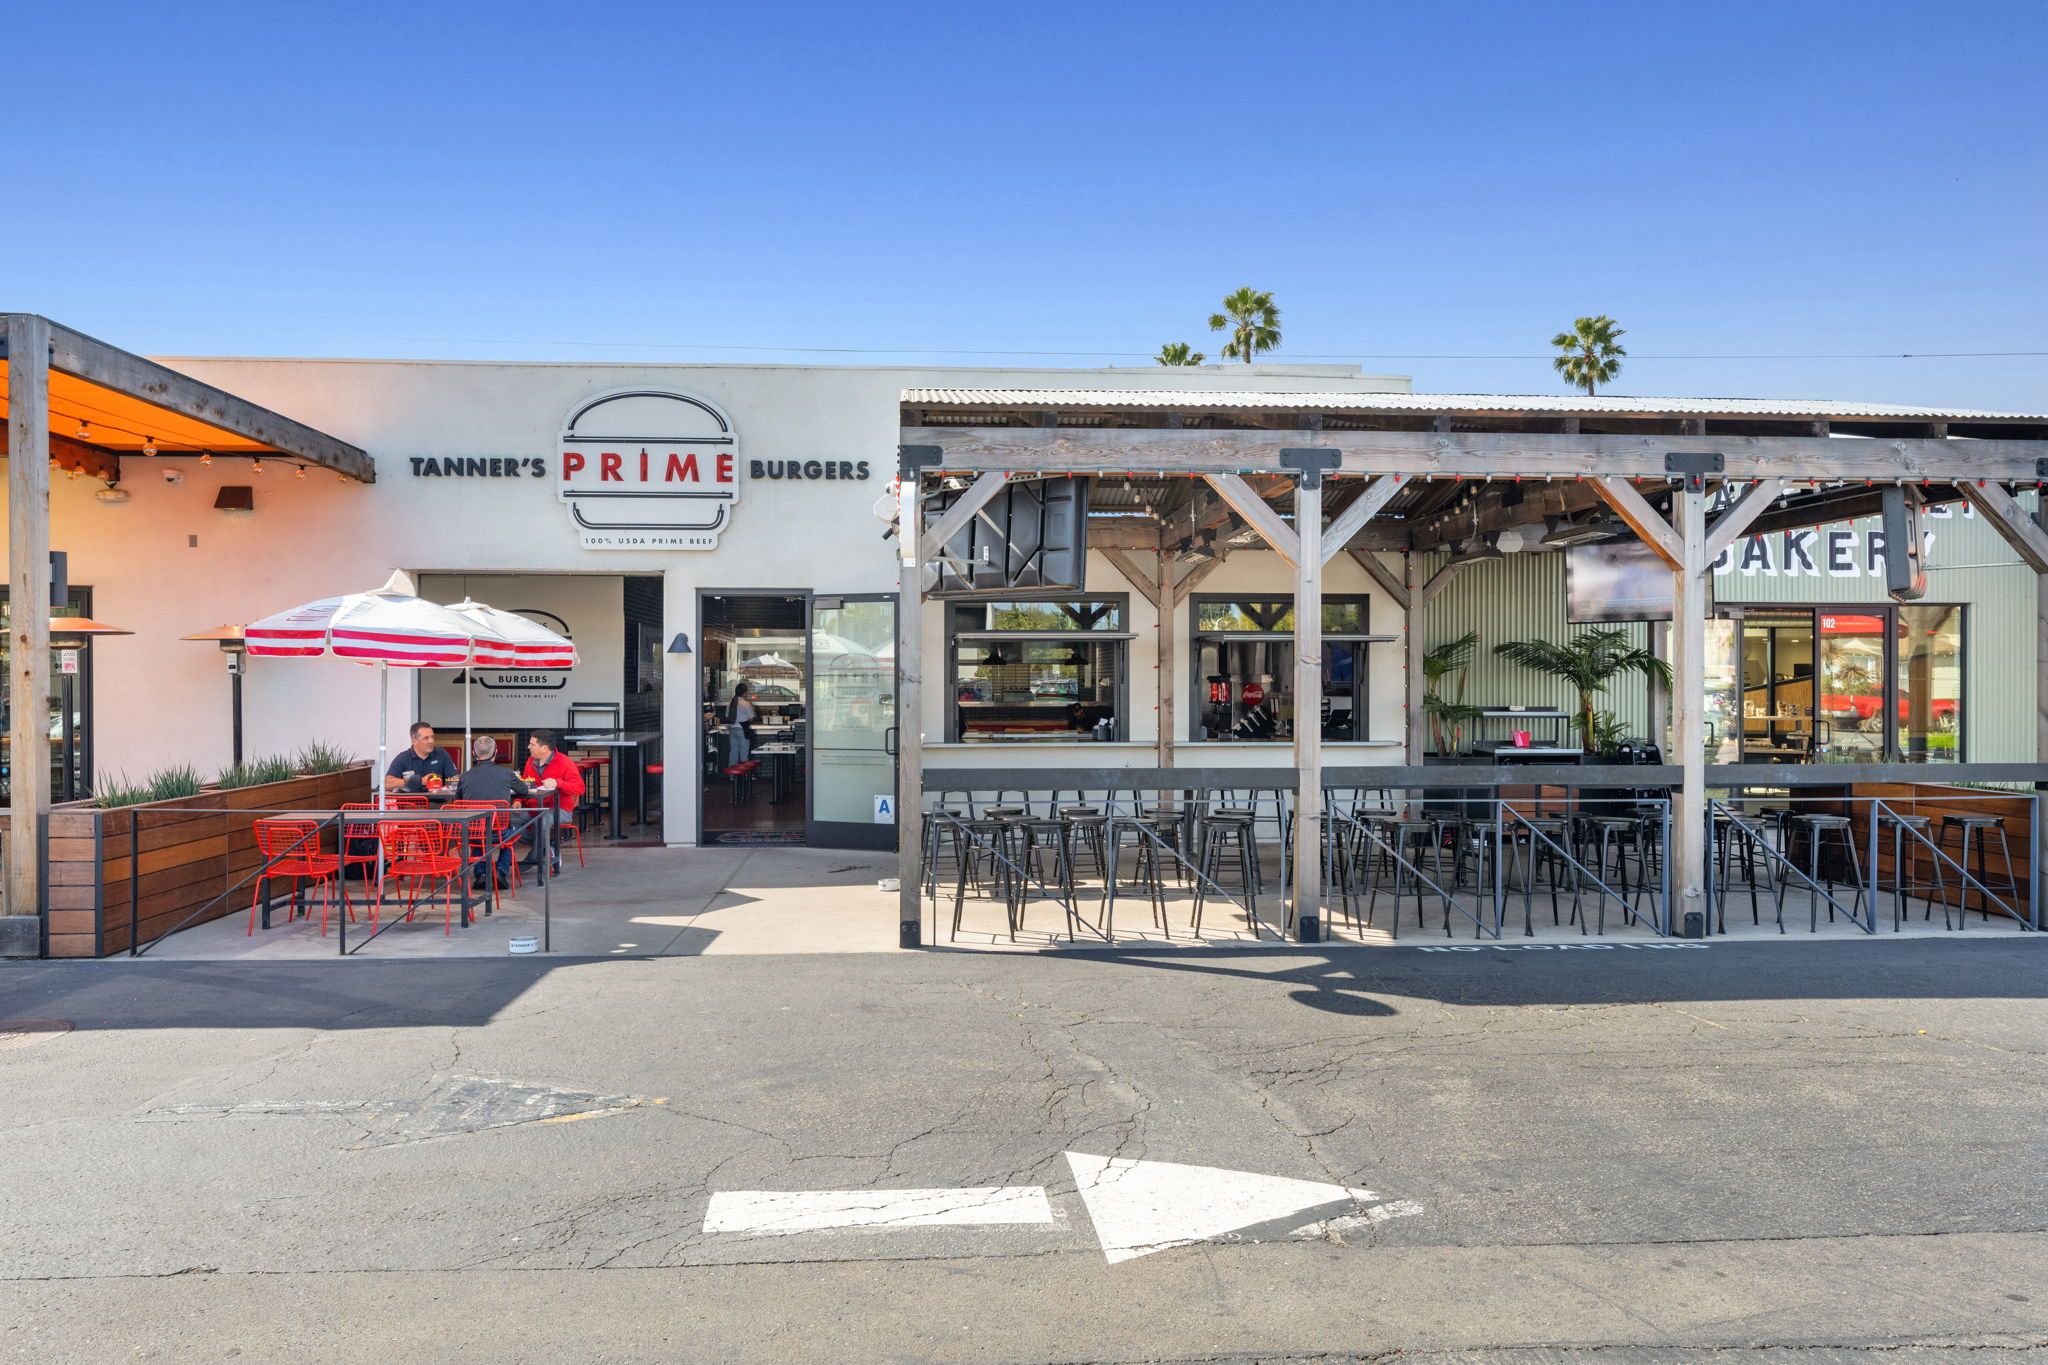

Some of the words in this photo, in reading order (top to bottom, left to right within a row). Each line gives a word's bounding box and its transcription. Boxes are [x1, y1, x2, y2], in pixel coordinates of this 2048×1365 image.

[409, 457, 546, 478] TANNER'S
[563, 452, 733, 483] PRIME
[750, 460, 870, 480] BURGERS
[1713, 526, 1936, 578] AKER
[1822, 618, 1836, 628] 102
[498, 675, 548, 683] BURGERS
[879, 799, 890, 814] A
[1491, 943, 1711, 951] LOADING
